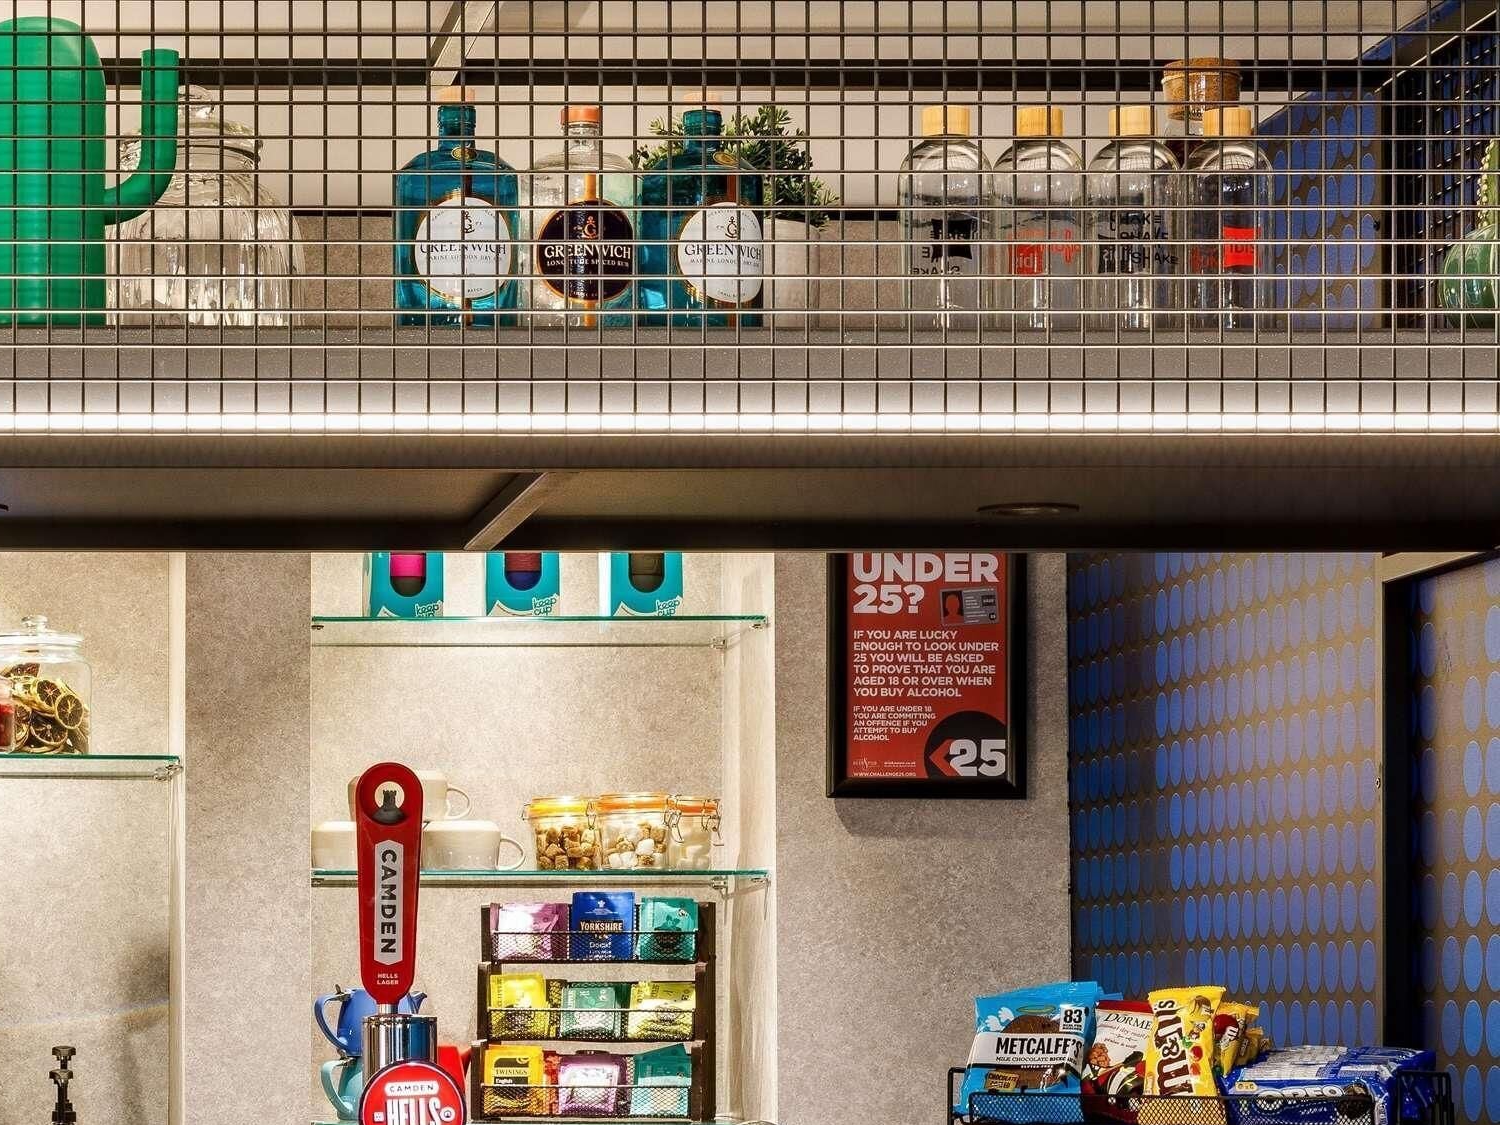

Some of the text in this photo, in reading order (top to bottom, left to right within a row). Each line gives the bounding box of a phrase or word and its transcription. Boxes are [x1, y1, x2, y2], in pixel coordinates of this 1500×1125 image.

[544, 243, 631, 259] GREENWICH
[684, 243, 762, 260] GREENWICH
[853, 552, 999, 583] UNDER
[533, 597, 557, 610] keep
[656, 599, 682, 612] keep
[853, 584, 925, 614] 25?
[534, 605, 553, 617] cup
[853, 631, 957, 640] IF YOU ARE LUCKY
[853, 642, 999, 651] ENOUGH TO LOOK UNDER
[853, 654, 984, 663] 25 YOU WILL BE ASKED
[853, 665, 996, 674] TO PROVE THAT YOU ARE
[853, 677, 992, 686] AGED 18 OR OVER WHEN
[853, 688, 962, 697] YOU BUY ALCOHOL
[950, 739, 1006, 776] 25
[381, 849, 398, 954] CAMDEN
[580, 921, 623, 931] YORKSHIRE
[1063, 1009, 1083, 1023] 83
[995, 1037, 1083, 1058] METCALFE'S
[389, 1084, 434, 1093] CAMDEN
